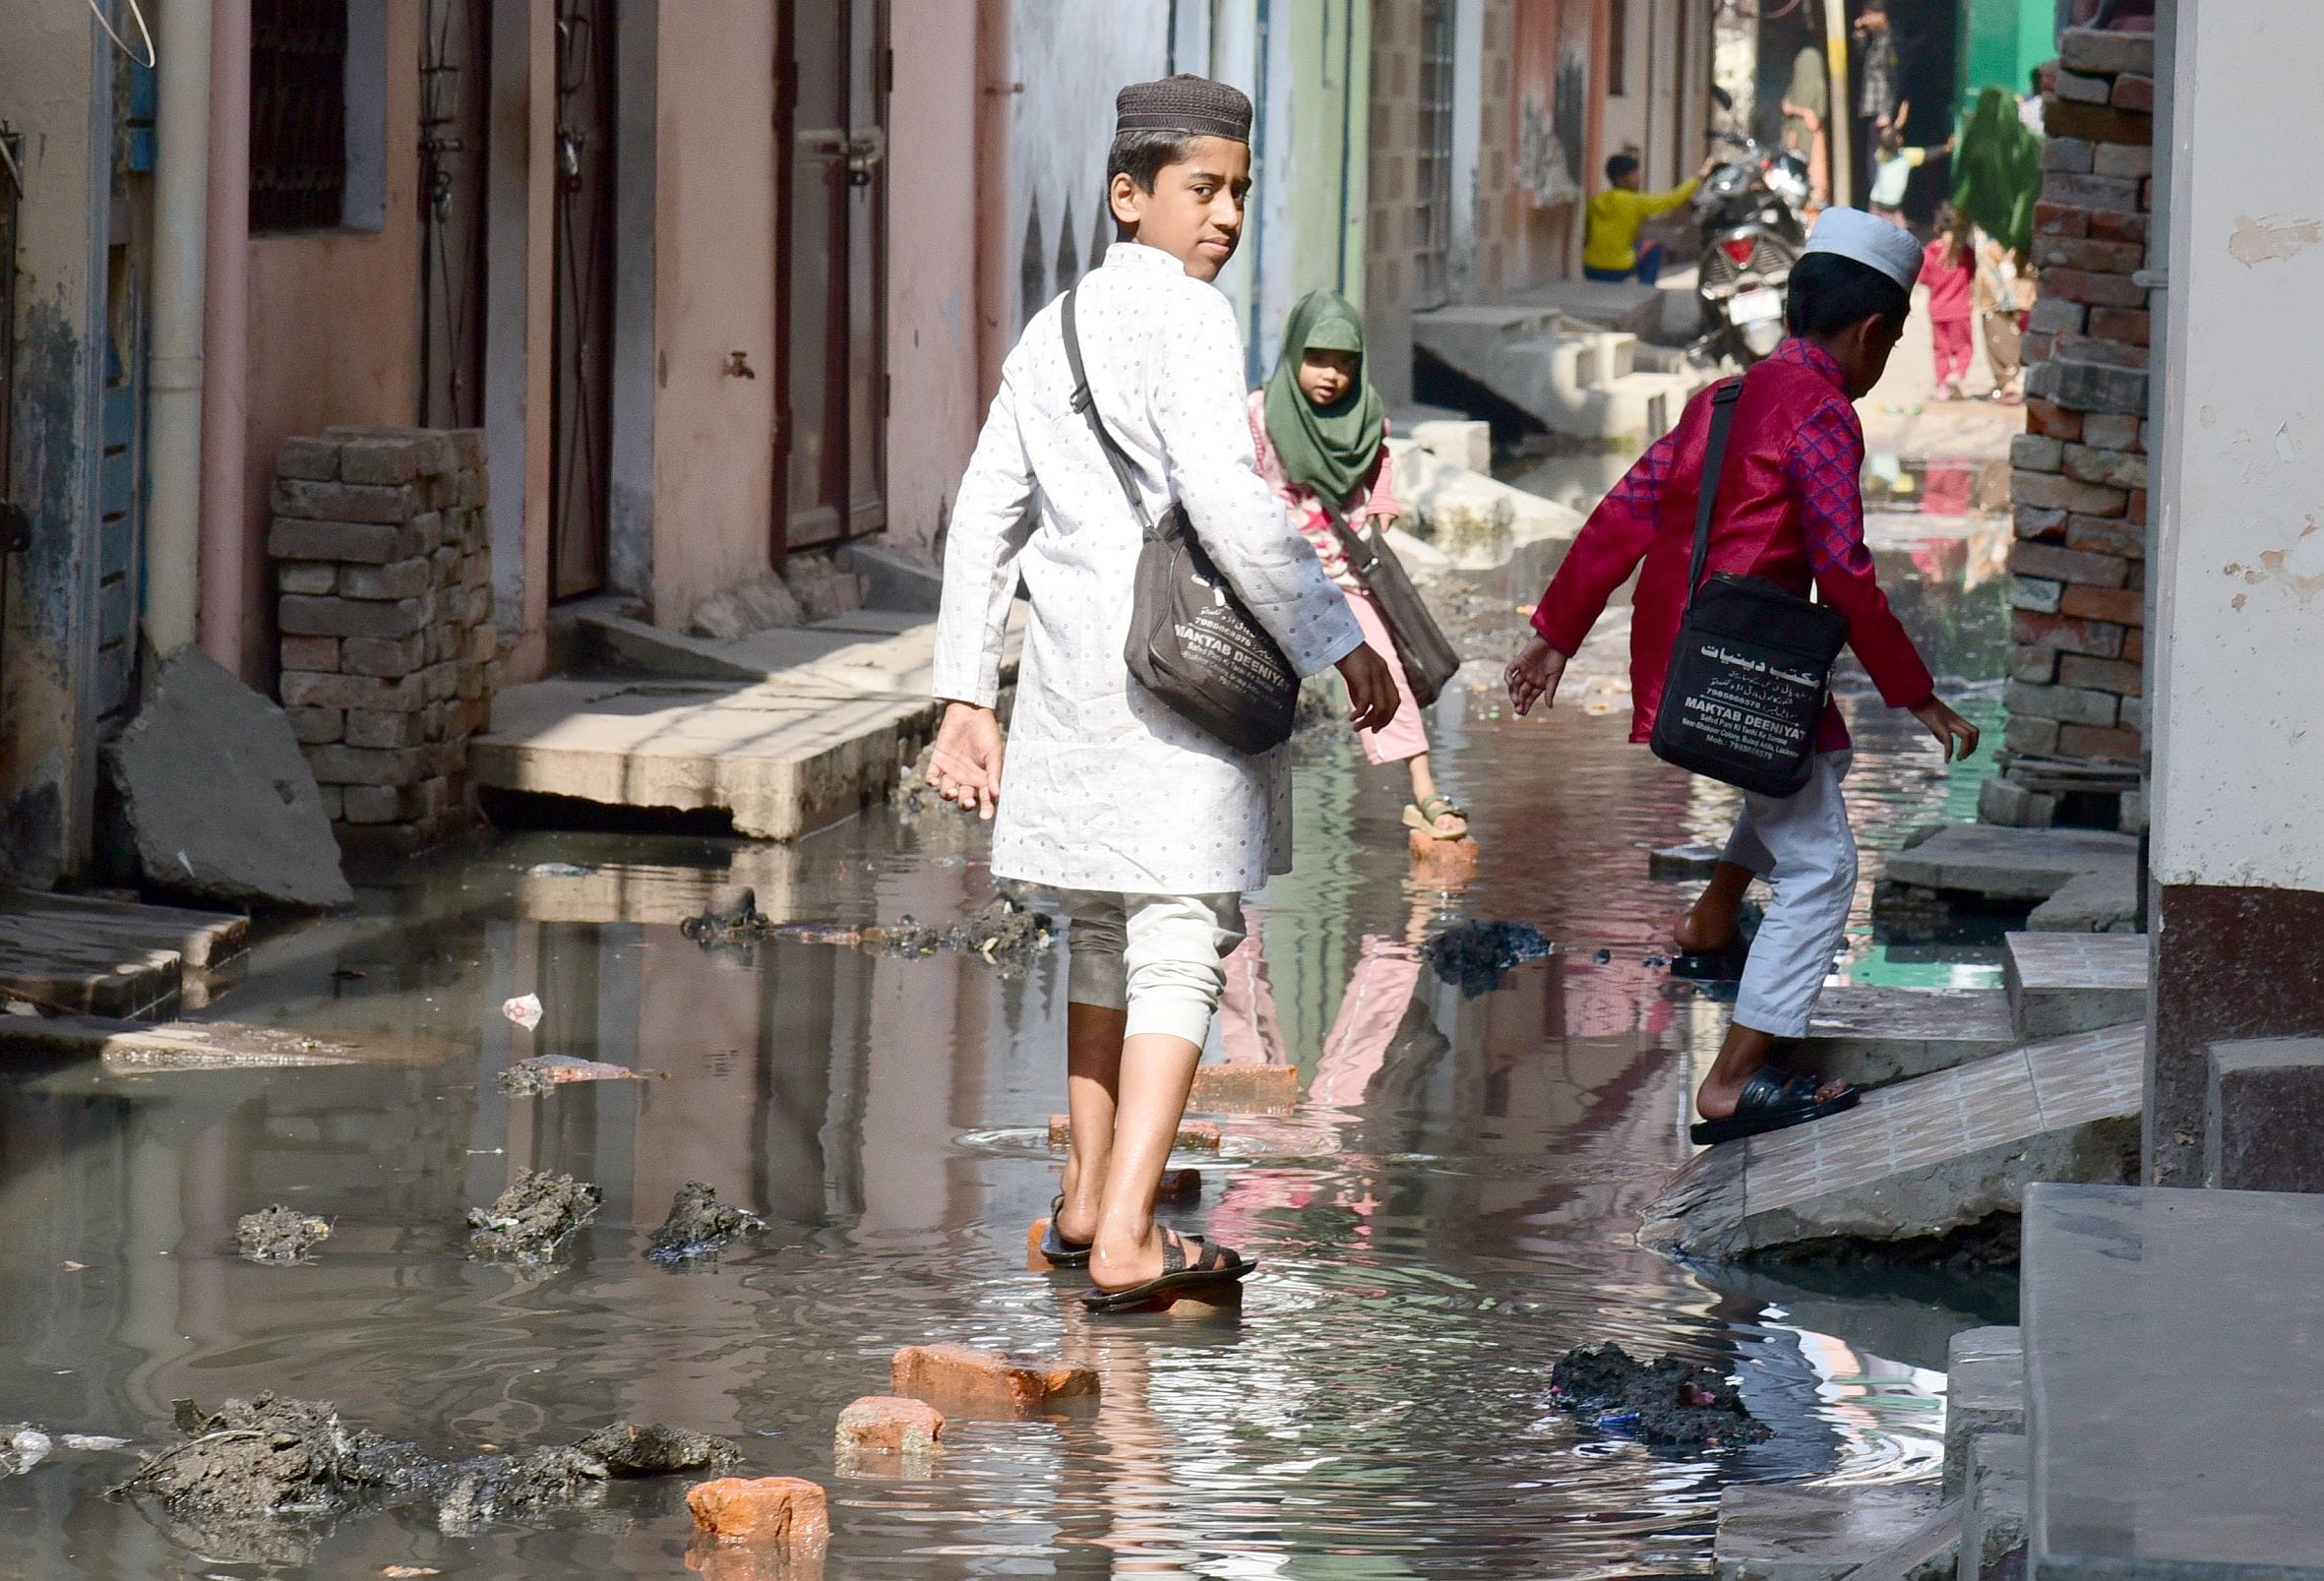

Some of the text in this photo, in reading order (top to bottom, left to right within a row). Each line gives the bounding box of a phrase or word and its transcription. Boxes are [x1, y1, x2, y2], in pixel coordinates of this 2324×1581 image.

[1701, 645, 1819, 689] مکتب دینیات
[1684, 697, 1805, 739] MAKTAB DEENIYAT
